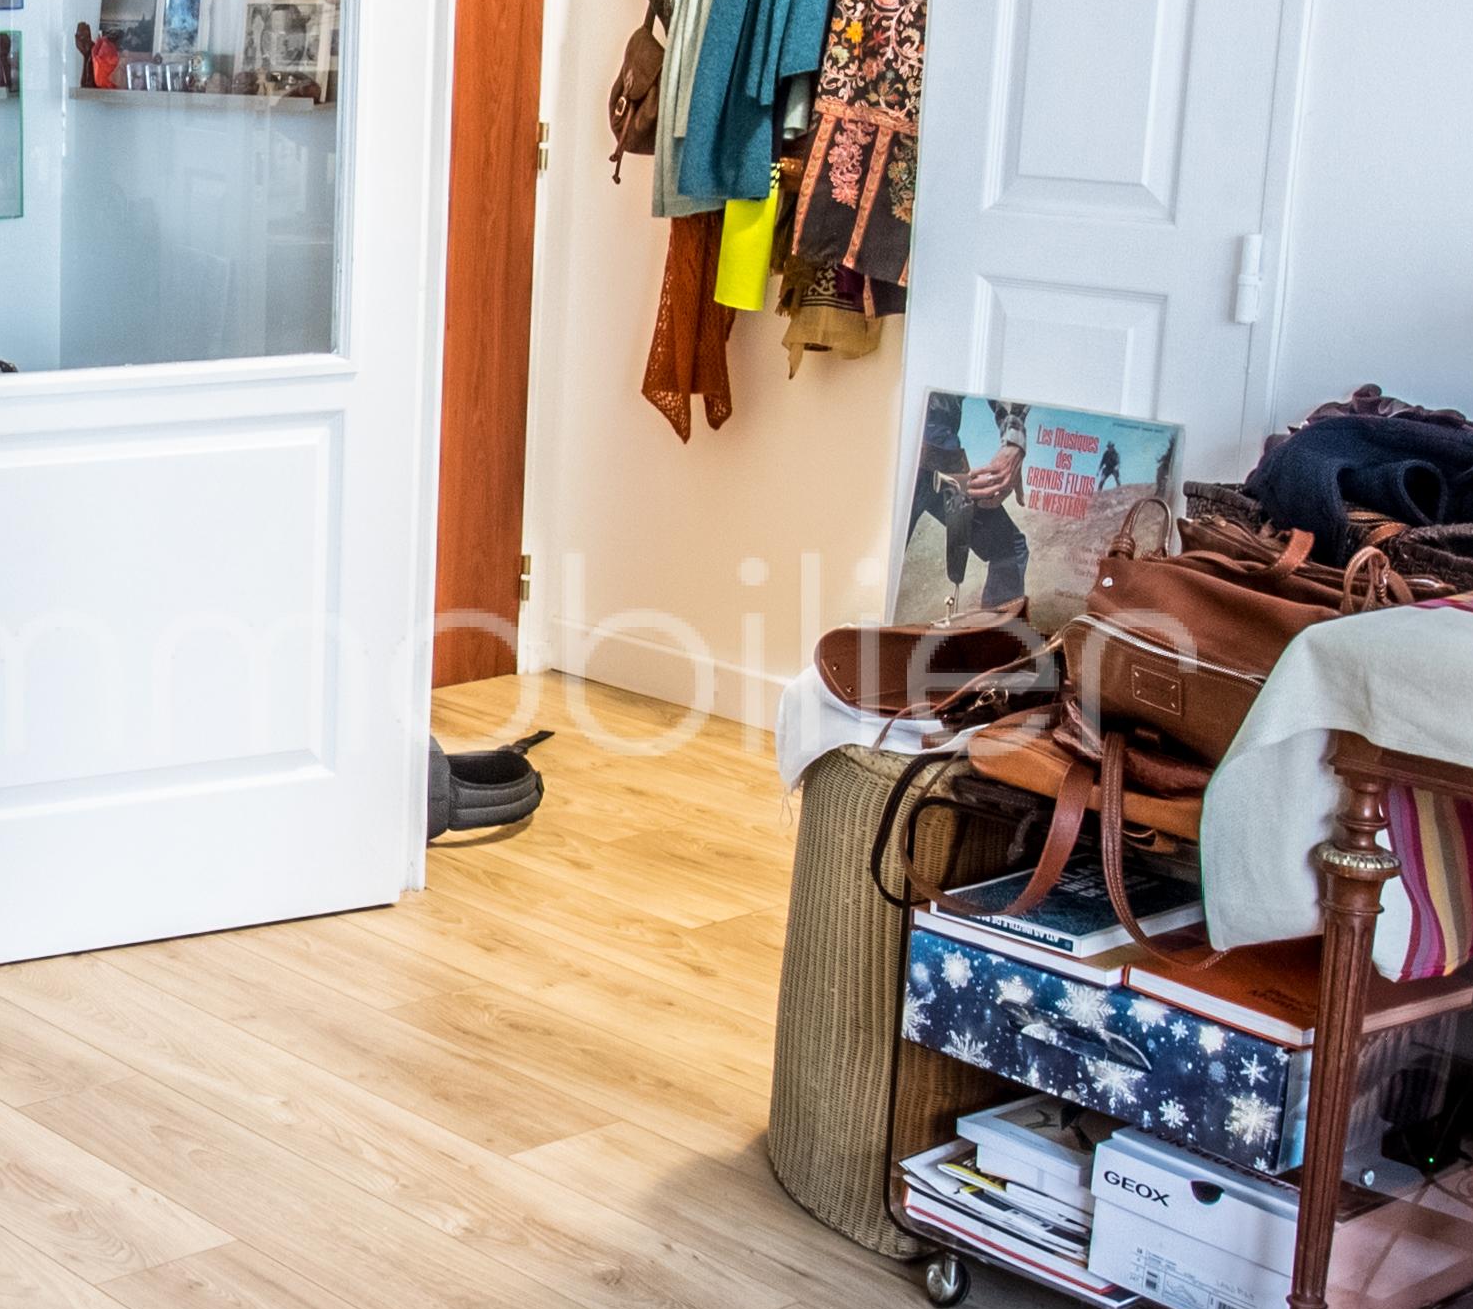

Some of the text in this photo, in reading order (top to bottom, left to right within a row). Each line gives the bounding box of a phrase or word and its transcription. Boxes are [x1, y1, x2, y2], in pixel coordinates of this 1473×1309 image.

[1036, 424, 1053, 446] Les
[1054, 427, 1100, 454] Musiques
[1056, 450, 1073, 470] des
[1026, 466, 1096, 498] GRANDS FILMS
[1028, 491, 1089, 520] DE WESTERN
[1034, 927, 1060, 944] ATLAS
[1104, 1170, 1170, 1207] GEOX
